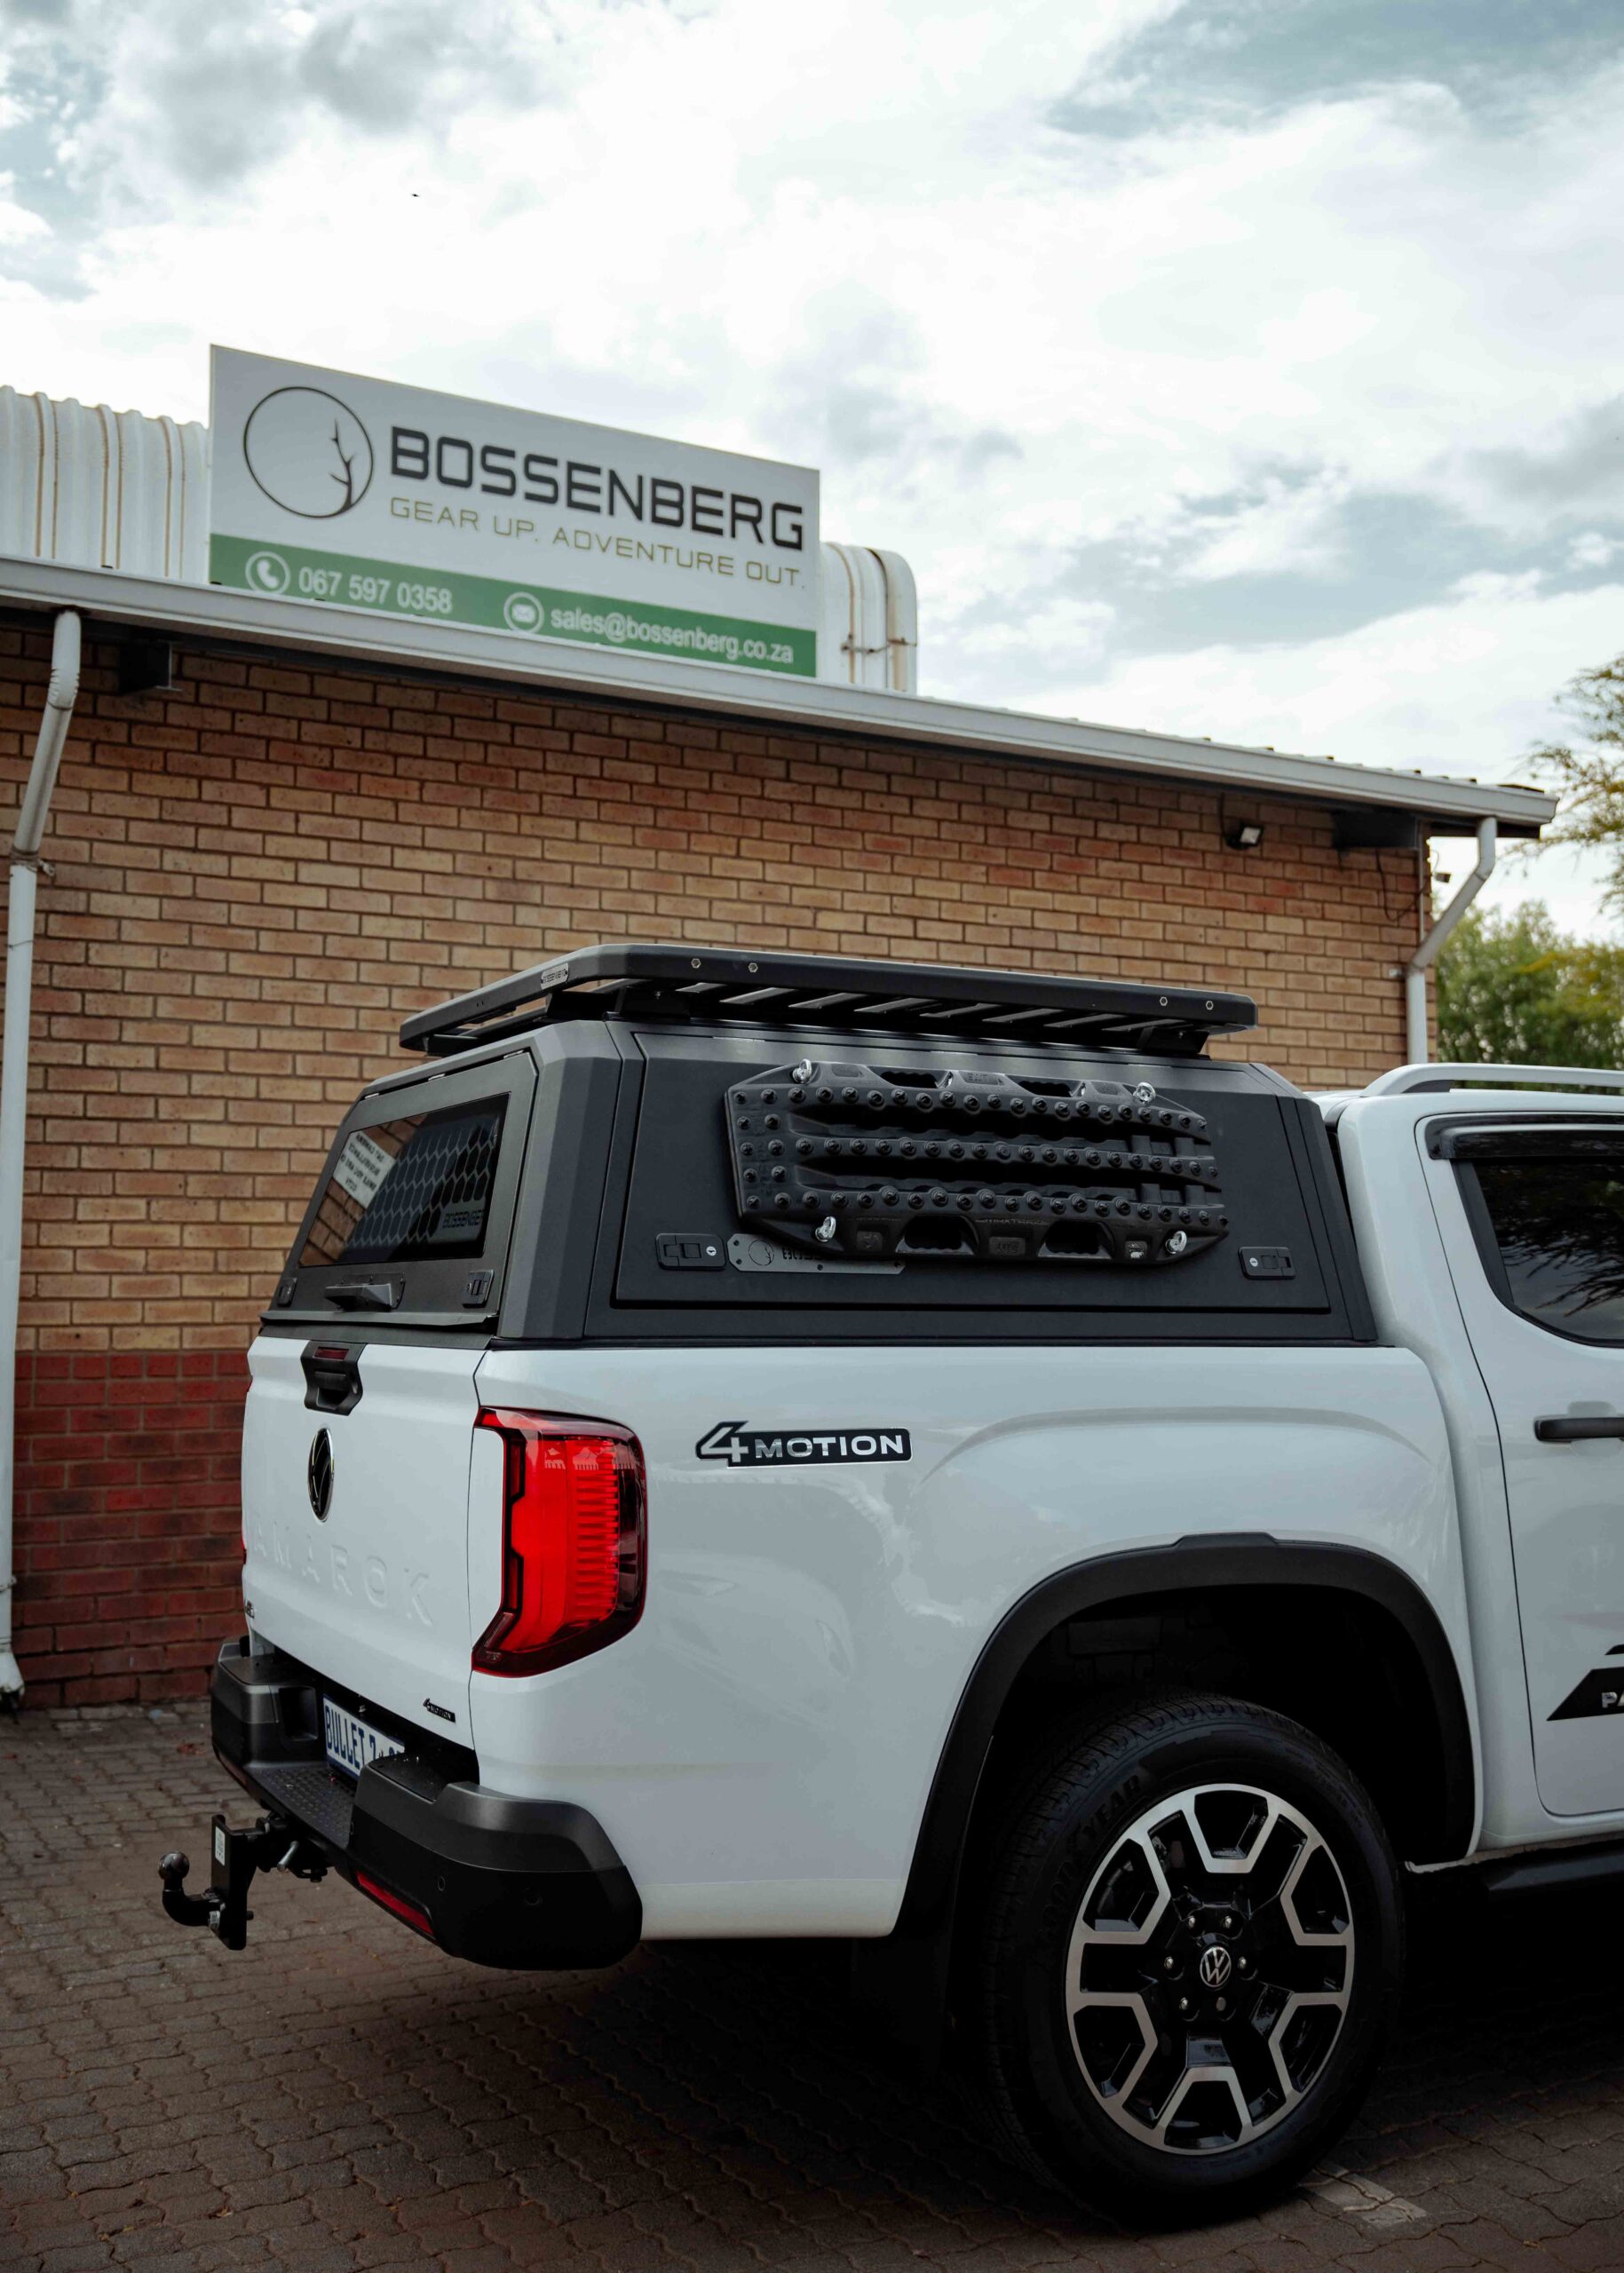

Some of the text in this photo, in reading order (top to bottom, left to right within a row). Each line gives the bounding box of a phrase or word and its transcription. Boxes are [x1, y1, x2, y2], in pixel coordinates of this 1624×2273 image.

[392, 425, 803, 550] BOSSENBERG
[390, 496, 479, 531] GEAR
[494, 515, 538, 543] UP.
[552, 527, 734, 575] ADVENTURE
[298, 566, 794, 663] 067 597 0358 sales@bossenberg.co.za
[698, 1422, 905, 1464] 4MOTION
[325, 1705, 365, 1770] BULLET
